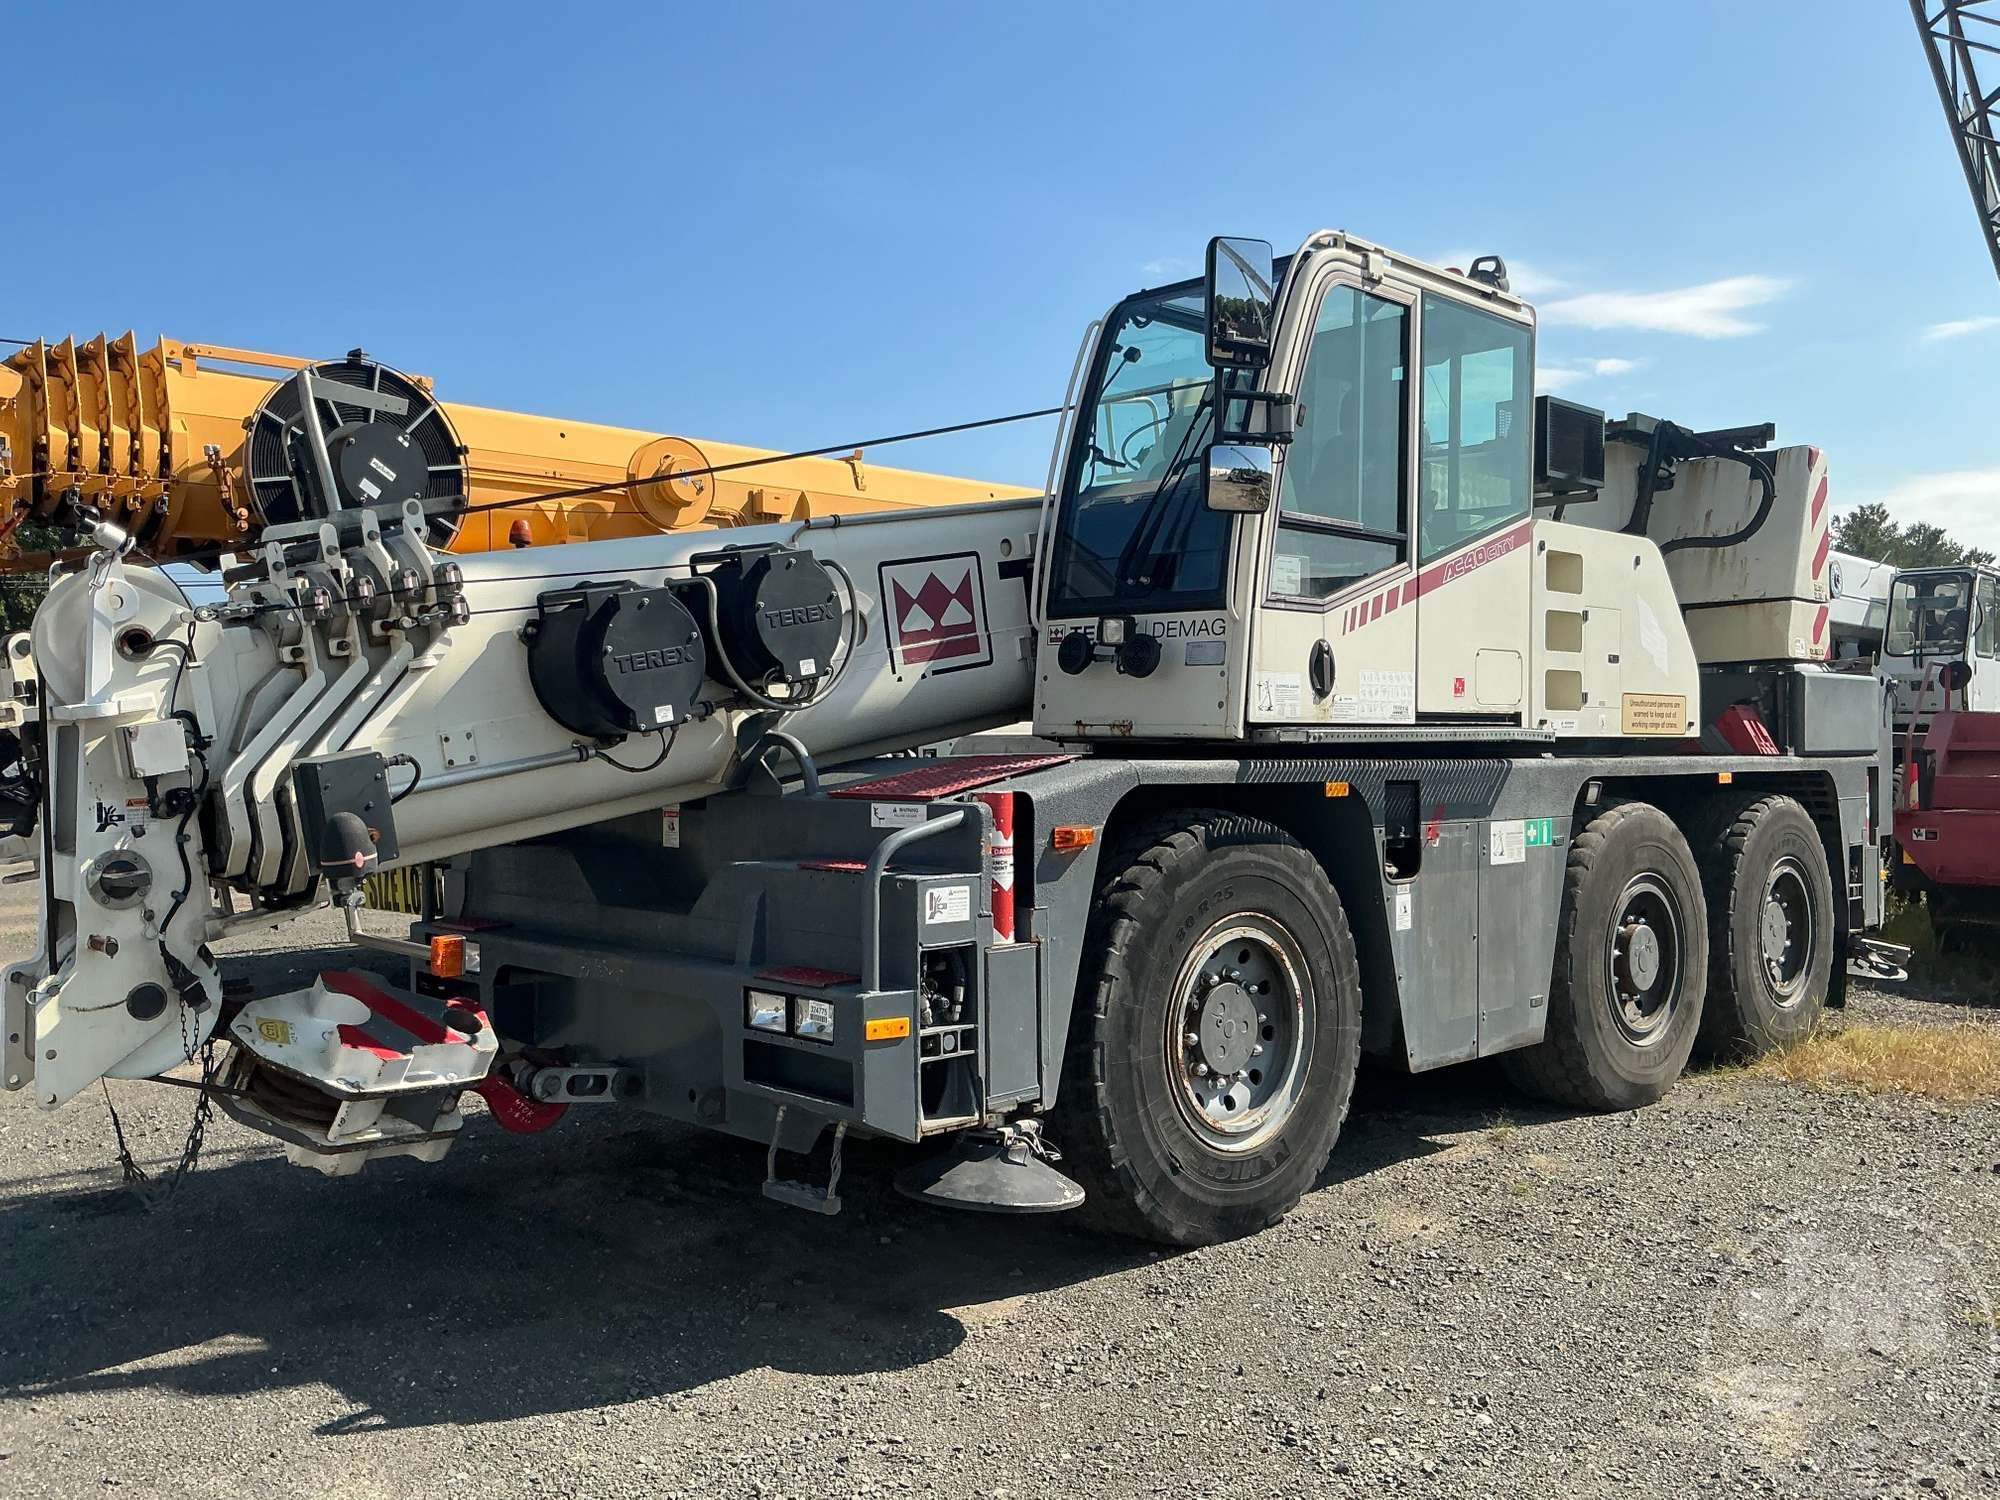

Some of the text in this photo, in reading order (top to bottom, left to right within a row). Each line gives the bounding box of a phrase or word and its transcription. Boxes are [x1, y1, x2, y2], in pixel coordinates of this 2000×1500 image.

[765, 602, 835, 629] TEREX
[1152, 618, 1226, 639] DEMAG
[613, 645, 696, 674] TEREX
[1657, 701, 1673, 710] persons
[1654, 711, 1664, 719] keep
[1632, 721, 1648, 730] working
[1648, 722, 1661, 730] range
